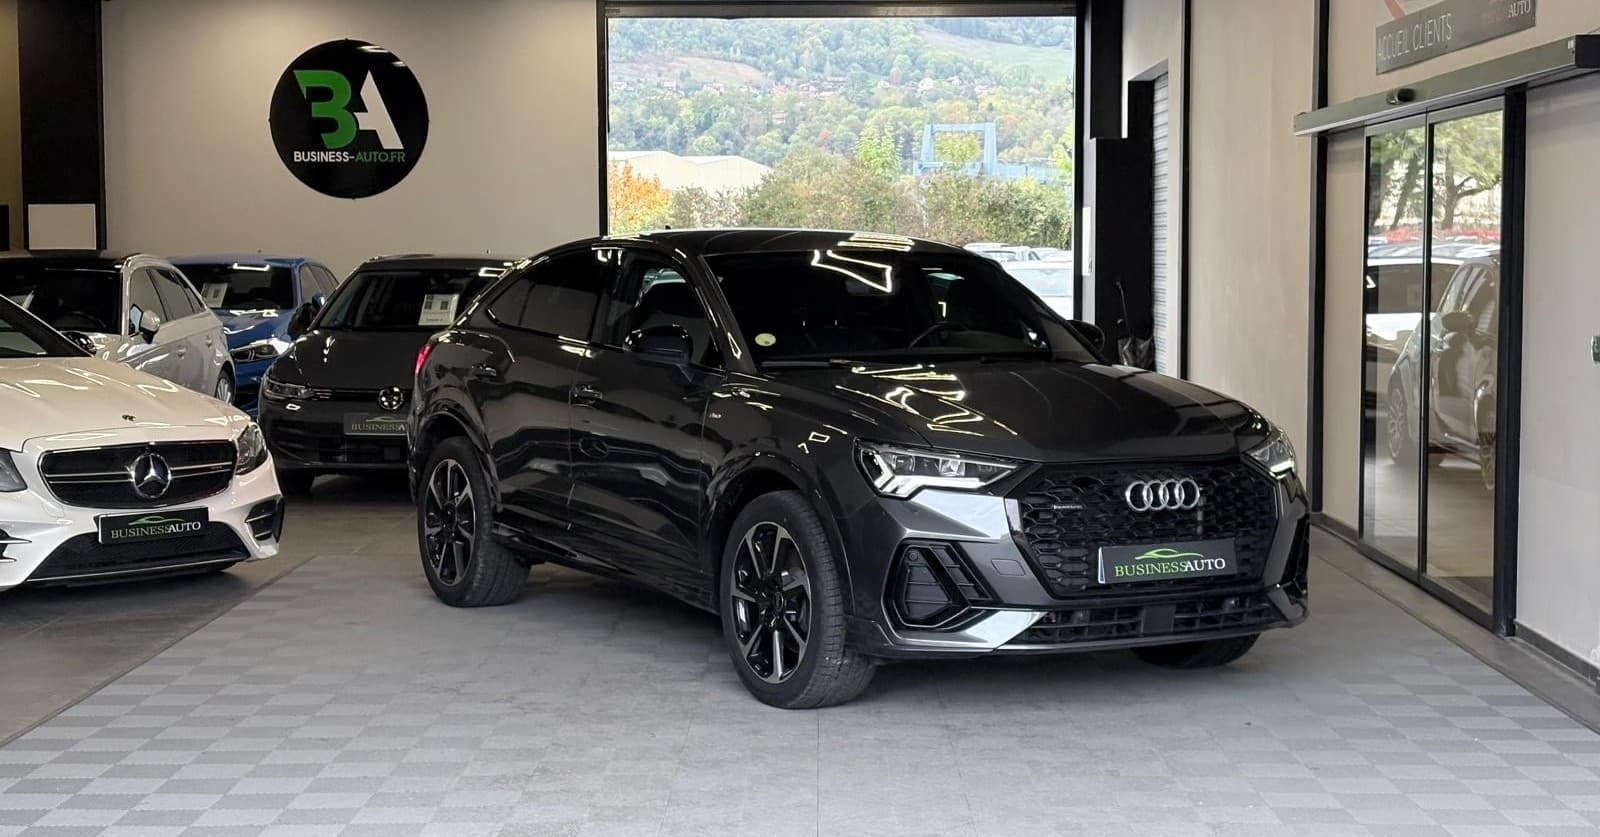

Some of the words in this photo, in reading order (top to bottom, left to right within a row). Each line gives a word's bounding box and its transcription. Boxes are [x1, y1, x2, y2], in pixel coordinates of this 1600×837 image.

[1378, 28, 1410, 61] ACCUEIL
[1412, 13, 1453, 51] CLIENTS
[293, 151, 406, 163] BUSINESS-AUTO.FR
